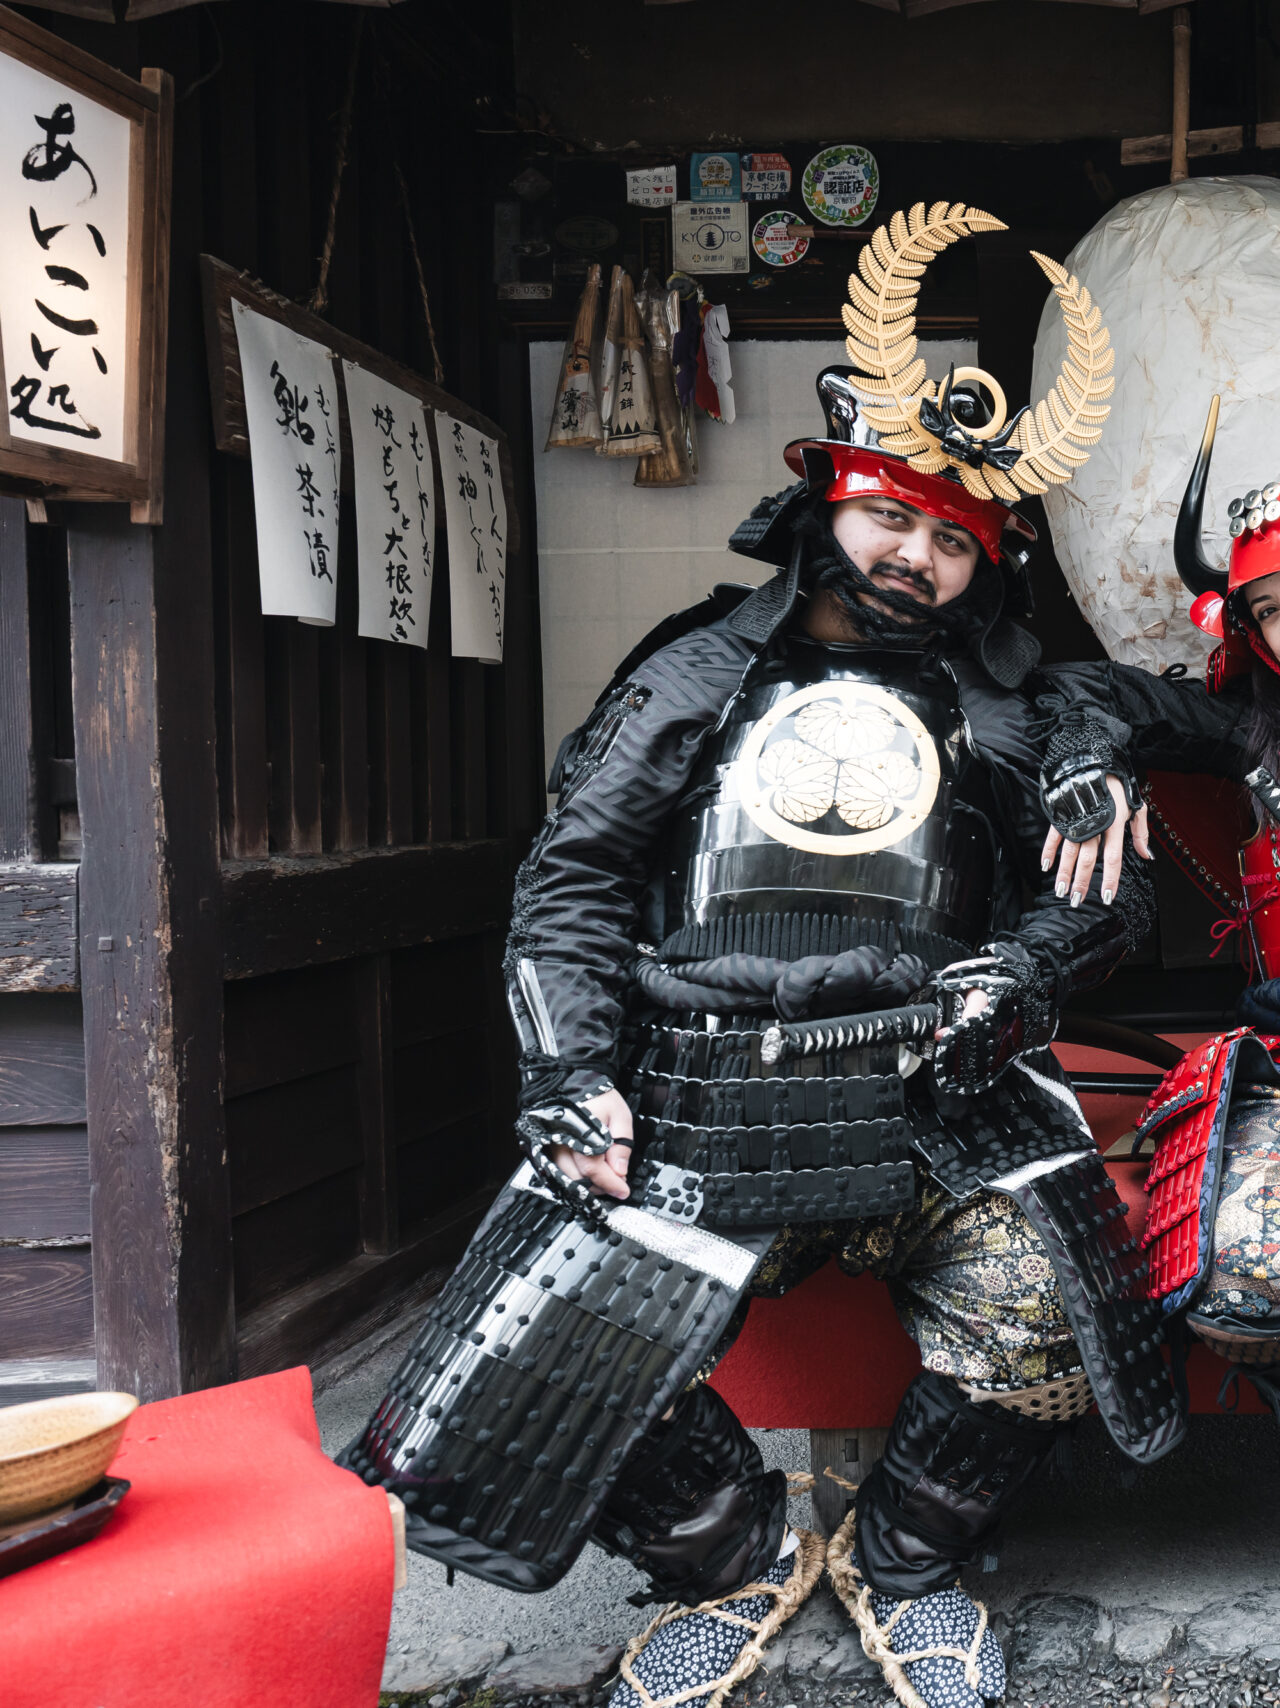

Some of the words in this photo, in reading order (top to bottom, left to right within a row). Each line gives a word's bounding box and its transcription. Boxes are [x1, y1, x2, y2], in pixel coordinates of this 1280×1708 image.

[630, 174, 673, 184] 食べ残し
[630, 186, 650, 195] ゼロ
[745, 182, 788, 192] クーポン券
[823, 179, 865, 195] 認証店
[833, 196, 857, 205] 京都府
[704, 254, 725, 263] 京都市
[269, 360, 334, 586] 鮎茶漬
